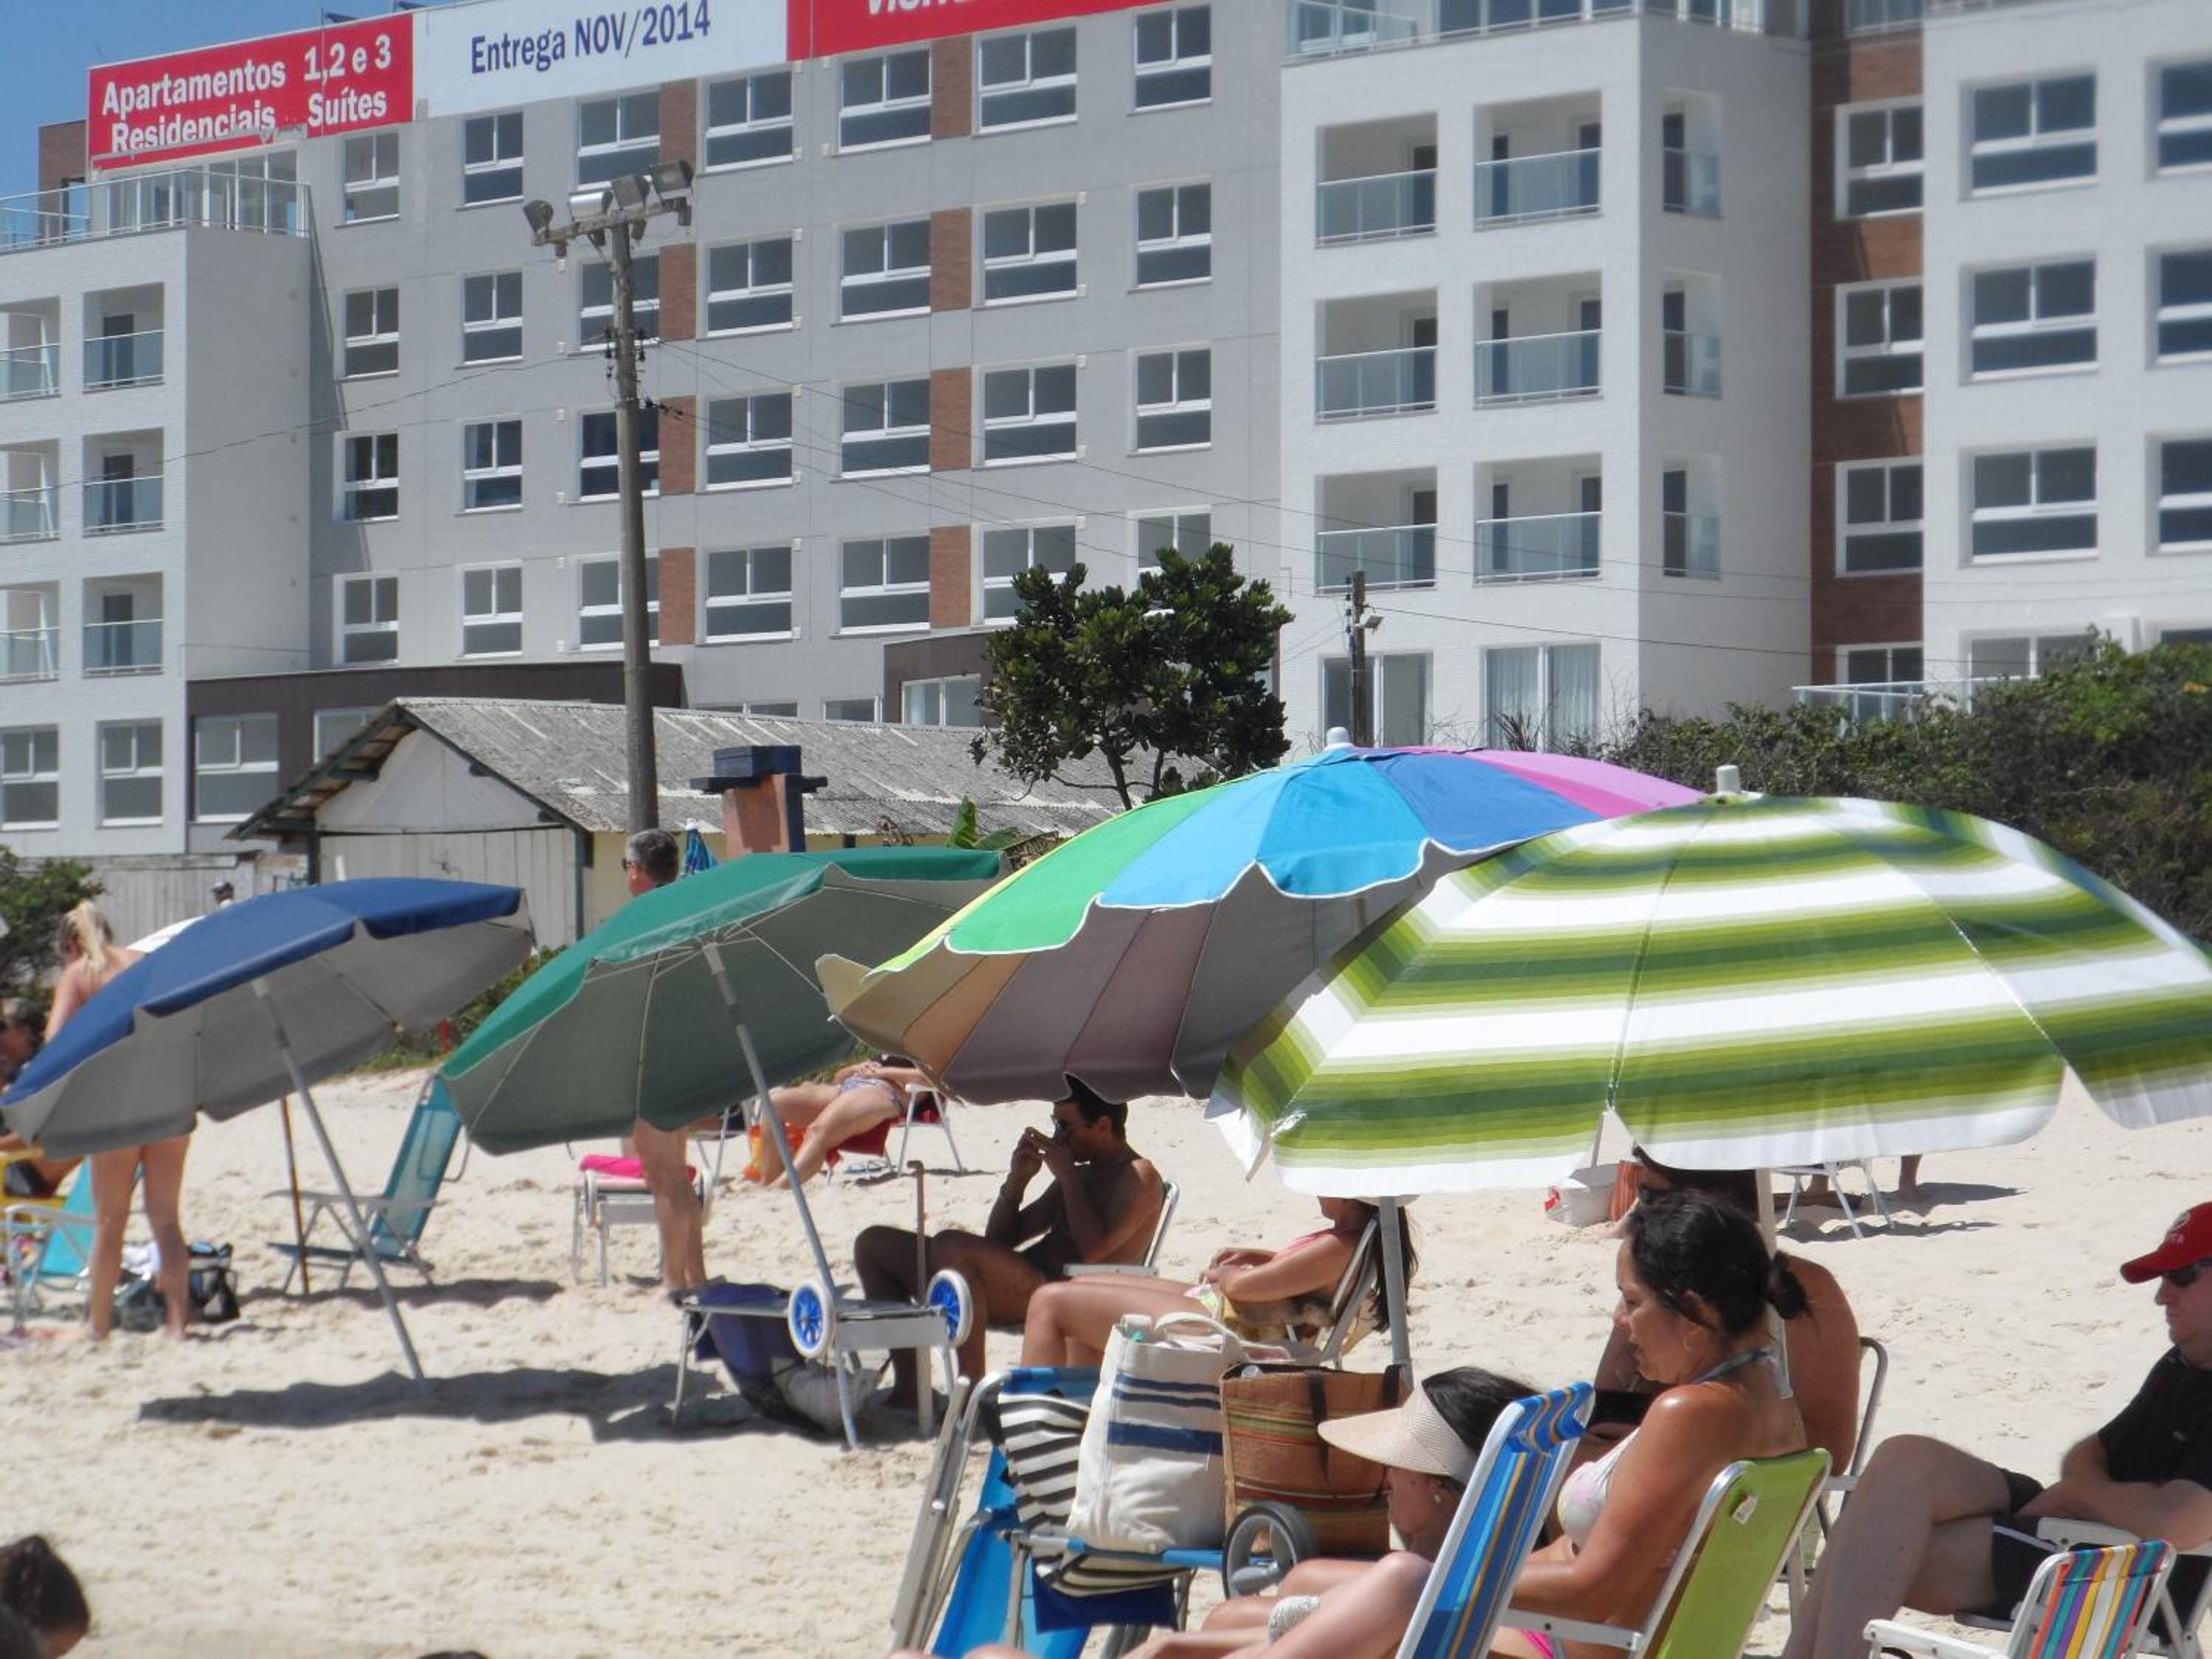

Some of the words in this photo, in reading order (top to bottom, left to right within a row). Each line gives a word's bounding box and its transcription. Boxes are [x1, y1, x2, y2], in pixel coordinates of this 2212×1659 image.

[471, 29, 566, 73] Entrega
[575, 0, 710, 59] NOV/2014
[101, 59, 285, 120] Apartamentos
[352, 46, 368, 74] e
[375, 34, 392, 69] 3
[111, 98, 276, 153] Residenciais
[307, 86, 387, 127] Suítes
